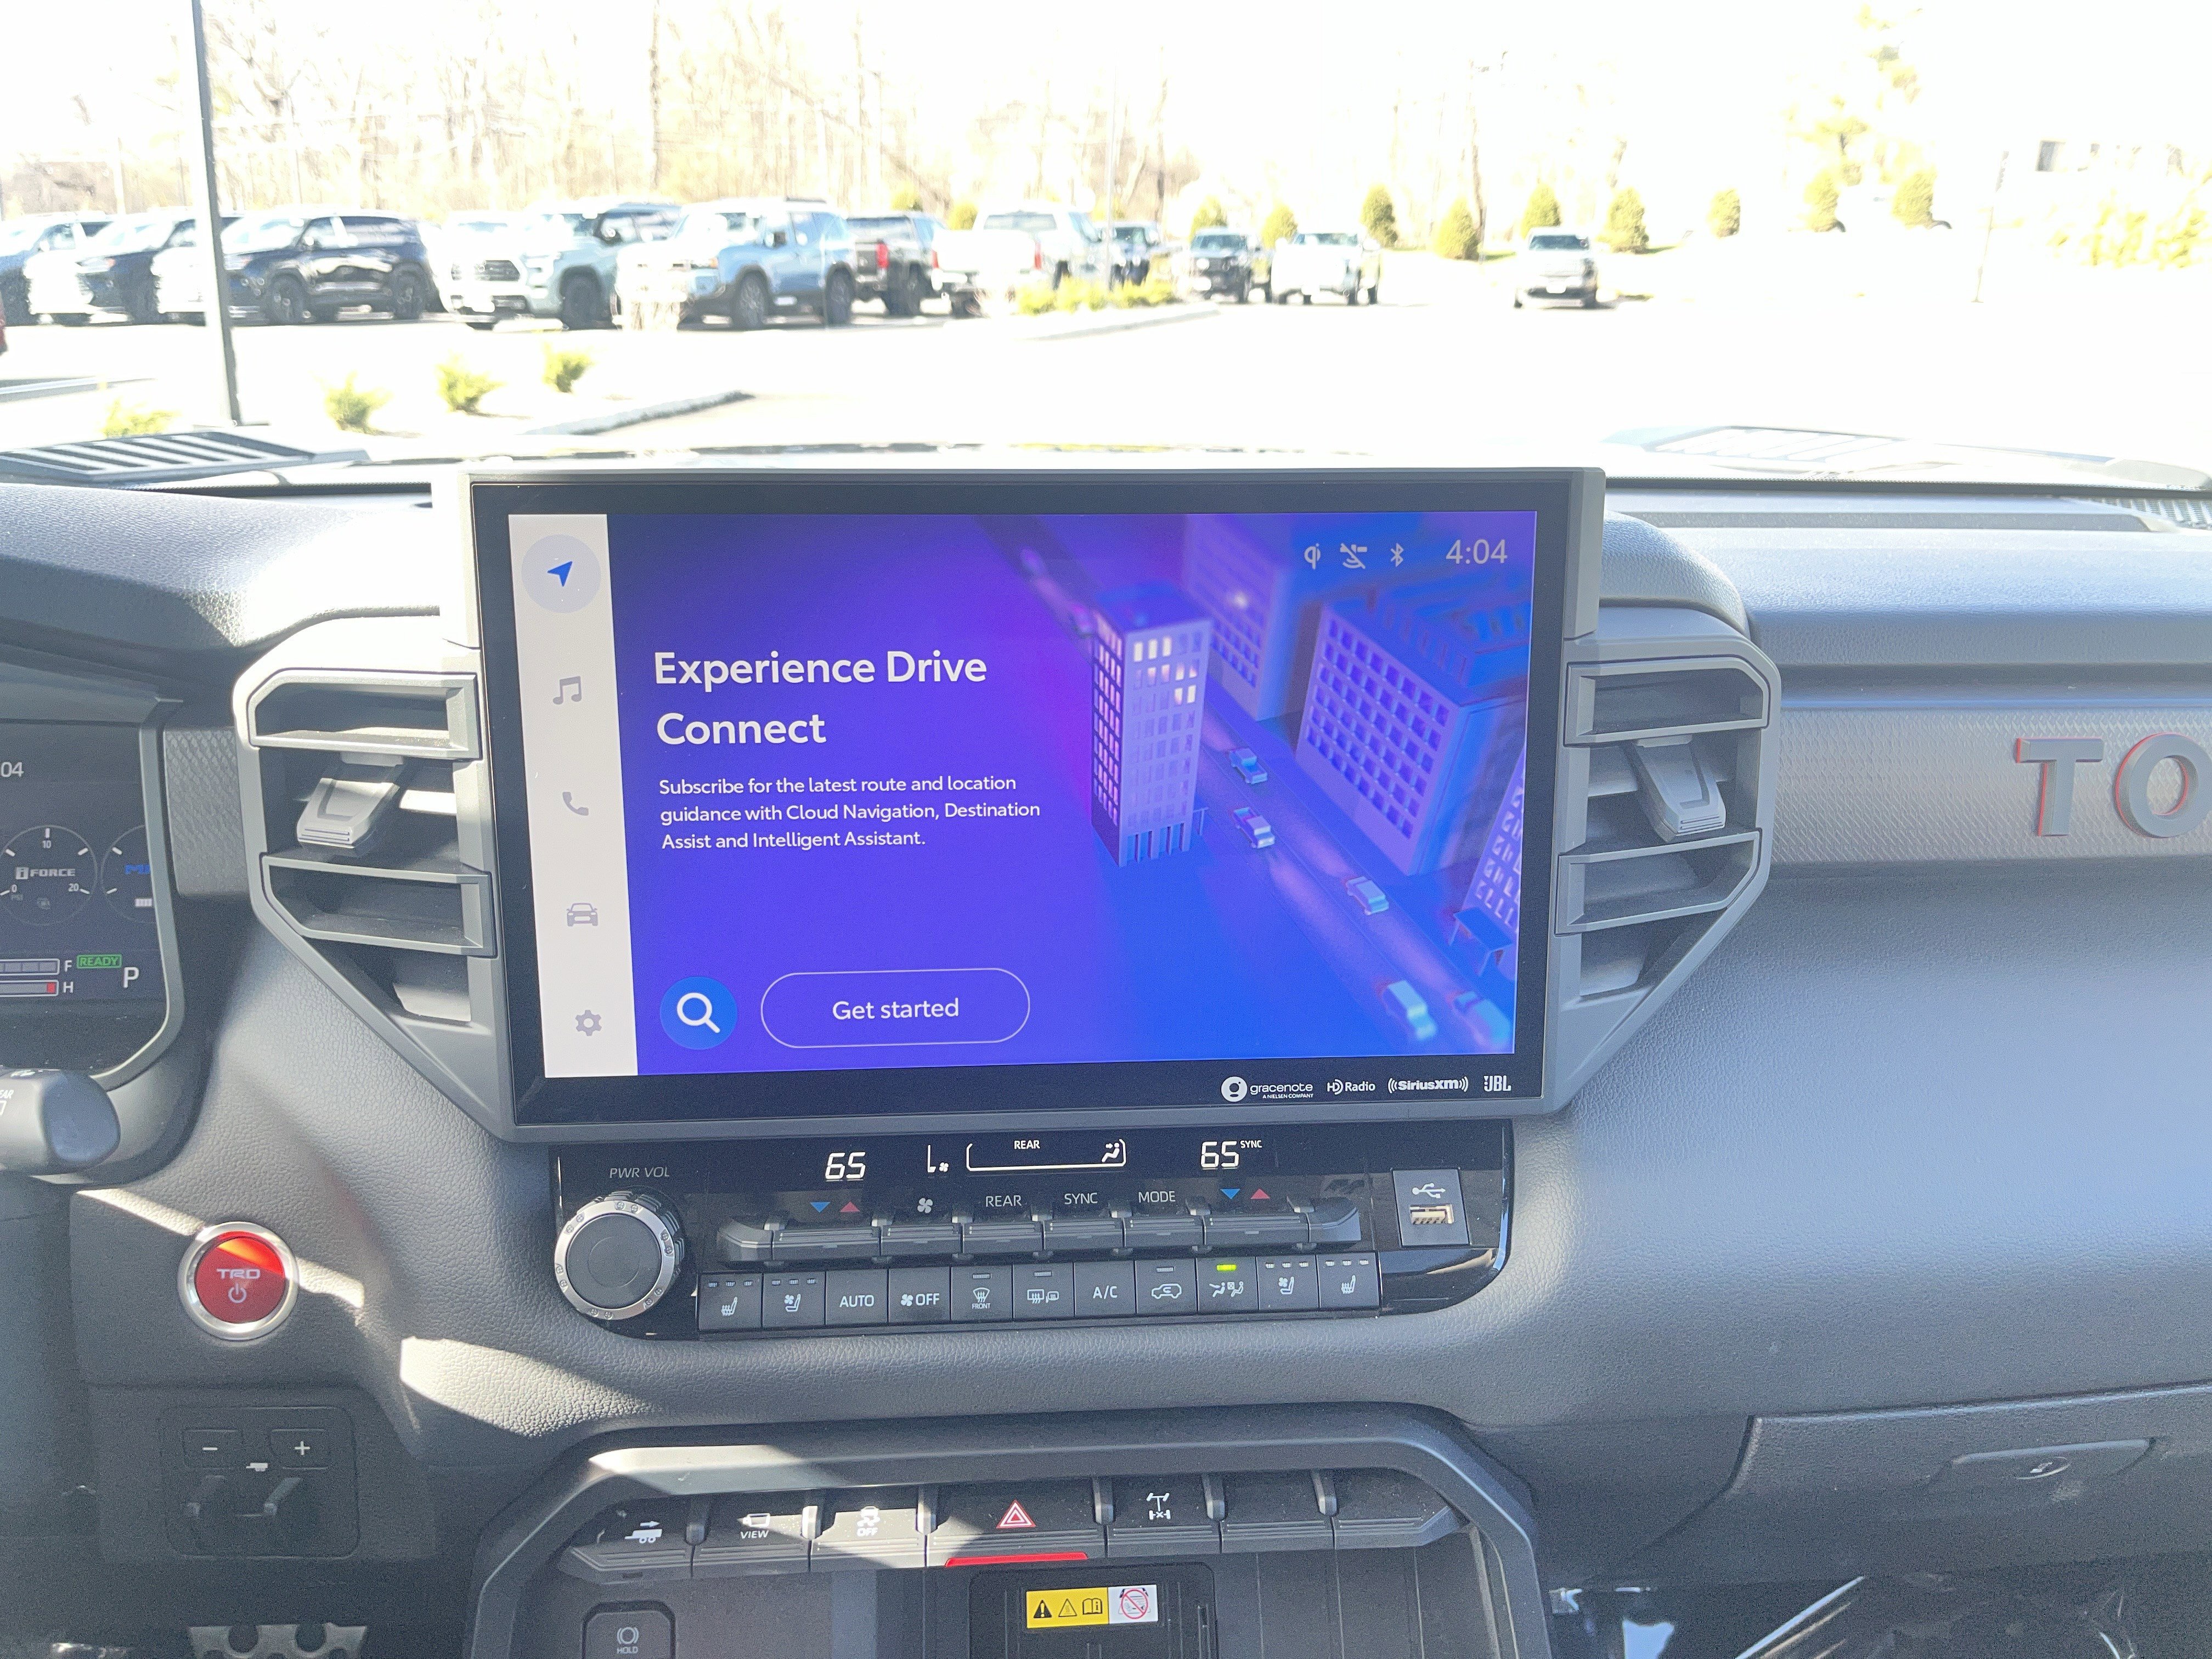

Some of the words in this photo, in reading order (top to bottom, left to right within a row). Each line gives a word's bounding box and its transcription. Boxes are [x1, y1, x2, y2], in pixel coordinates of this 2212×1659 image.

[1446, 539, 1508, 564] 4:04
[654, 650, 875, 692] Experience
[887, 650, 987, 682] Drive
[657, 713, 827, 745] Connect
[659, 778, 744, 794] Subscribe
[748, 778, 772, 793] for
[776, 777, 805, 793] the
[809, 777, 857, 792] latest
[861, 778, 907, 792] route
[911, 776, 943, 791] and
[947, 775, 1016, 791] location
[2014, 731, 2212, 839] TO
[661, 806, 741, 826] guidance
[744, 805, 782, 820] with
[786, 804, 838, 820] Cloud
[843, 803, 939, 822] Navigation,
[945, 802, 1040, 817] Destination
[42, 840, 52, 849] 10
[662, 834, 712, 849] Assist
[715, 832, 748, 848] and
[753, 832, 841, 850] Intelligent
[844, 831, 926, 846] Assistant.
[11, 884, 17, 893] 0
[68, 883, 79, 892] 20
[64, 960, 72, 972] F
[80, 957, 119, 966] READY
[123, 967, 139, 988] P
[63, 981, 74, 993] H
[832, 1001, 875, 1020] Get
[881, 997, 959, 1019] started
[1250, 1082, 1314, 1096] gracenote
[1345, 1081, 1376, 1092] Radio
[1014, 1139, 1040, 1149] REAR
[1240, 1140, 1262, 1149] SYNC
[1200, 1140, 1241, 1168] 65
[610, 1167, 640, 1178] PWR
[644, 1166, 670, 1178] VOL
[825, 1152, 866, 1181] 65
[985, 1195, 1022, 1207] REAR
[1064, 1192, 1098, 1205] SYNC
[1138, 1190, 1176, 1203] MODE
[216, 1268, 261, 1279] TRD
[1093, 1285, 1118, 1300] A/C
[839, 1295, 874, 1308] AUTO
[915, 1293, 940, 1306] OFF
[740, 1531, 769, 1540] VIEW
[856, 1528, 879, 1537] OFF
[616, 1646, 639, 1654] HOLD
